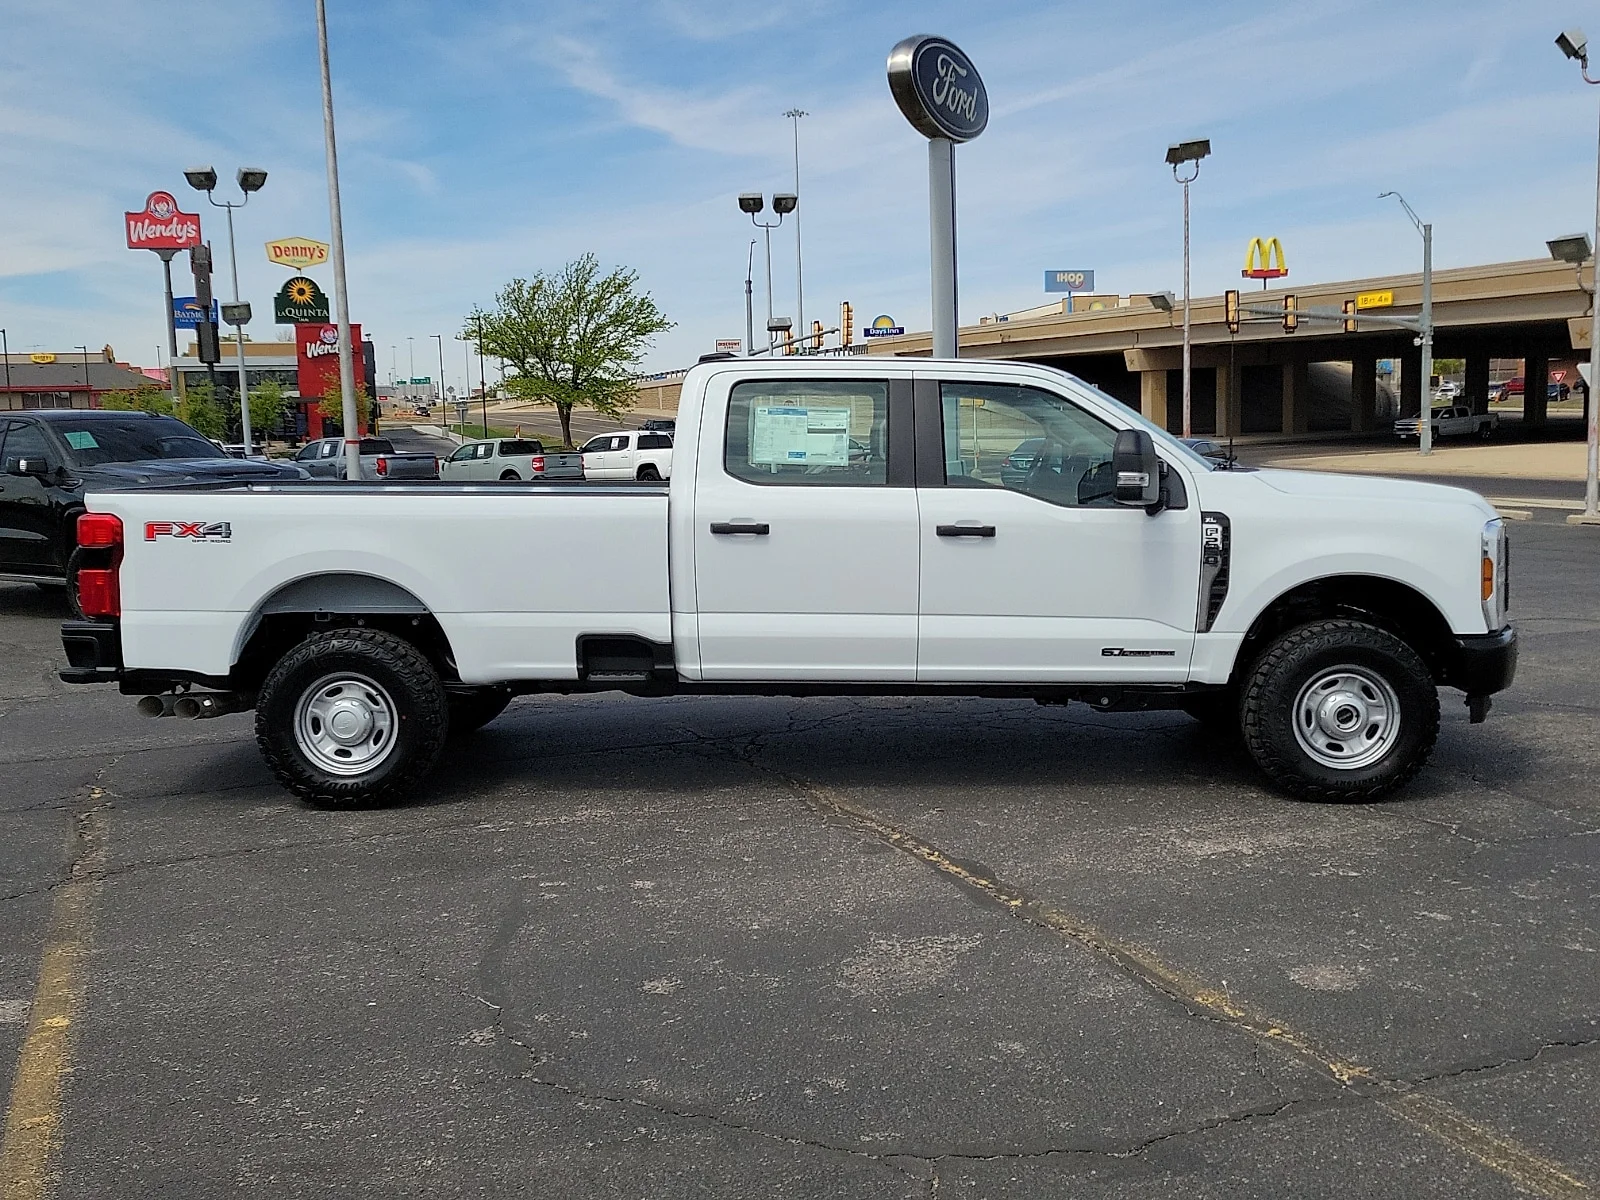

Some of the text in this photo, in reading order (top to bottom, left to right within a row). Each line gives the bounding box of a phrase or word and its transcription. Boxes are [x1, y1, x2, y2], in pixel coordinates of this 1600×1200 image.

[932, 53, 978, 122] Ford
[129, 217, 198, 243] Wendy's
[272, 245, 325, 260] Denny's
[285, 307, 330, 319] QUINTA
[870, 328, 887, 336] Days
[144, 521, 232, 541] FX4
